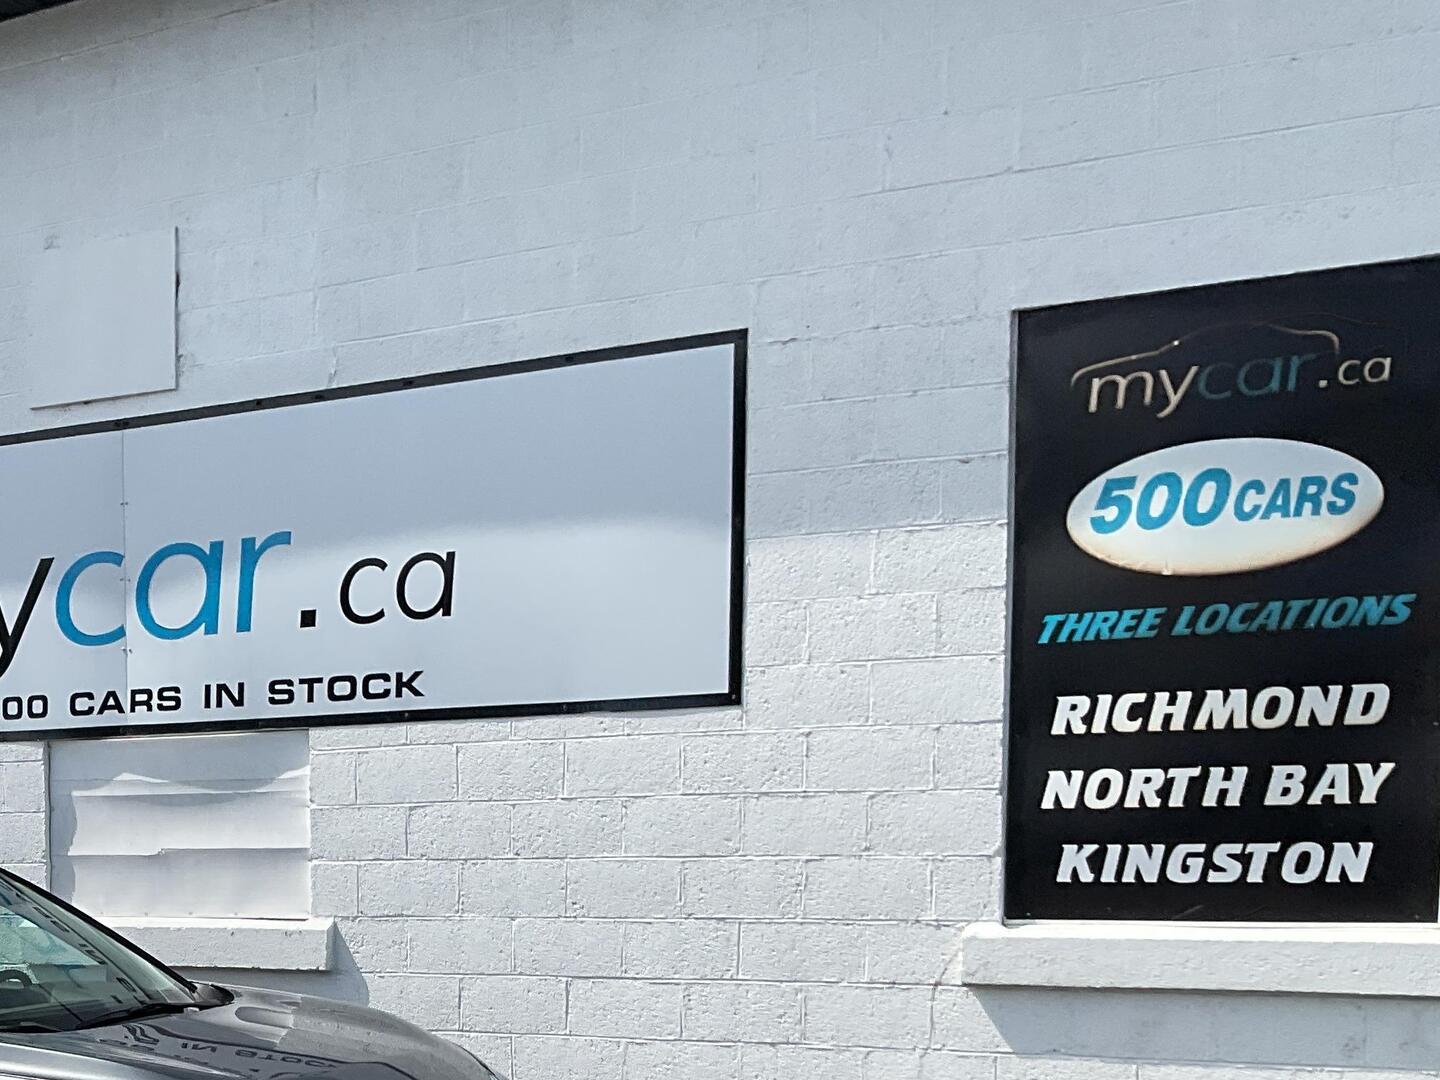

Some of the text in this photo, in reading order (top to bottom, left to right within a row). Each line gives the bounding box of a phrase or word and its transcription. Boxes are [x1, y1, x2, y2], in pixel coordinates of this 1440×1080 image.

[1087, 350, 1392, 418] mycar.ca
[1089, 467, 1359, 534] 500 CARS
[1037, 593, 1417, 644] THREE LOCATIONS
[69, 685, 182, 715] CARS
[204, 681, 246, 709] IN
[267, 670, 426, 704] STOCK
[1050, 683, 1391, 735] RICHMOND
[1040, 762, 1396, 810] NORTH BAY
[1056, 841, 1374, 884] KINGSTON
